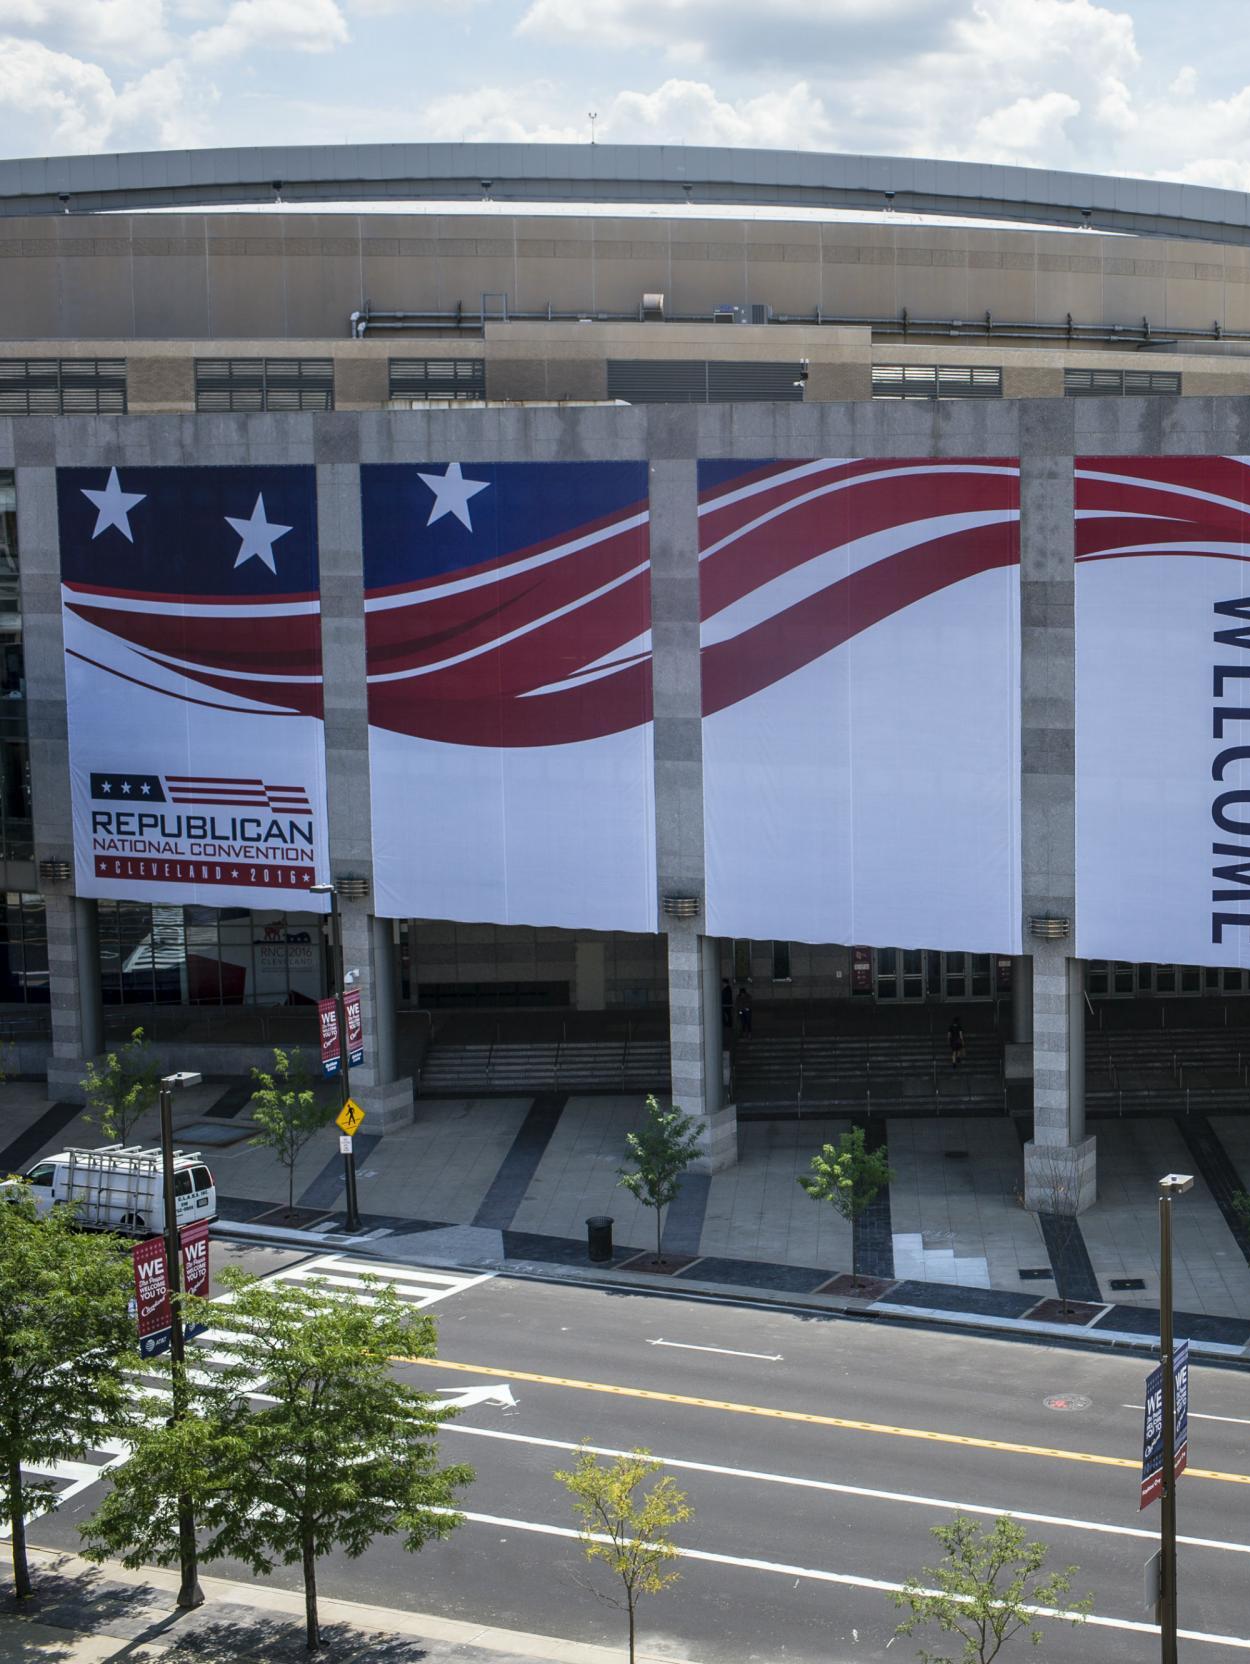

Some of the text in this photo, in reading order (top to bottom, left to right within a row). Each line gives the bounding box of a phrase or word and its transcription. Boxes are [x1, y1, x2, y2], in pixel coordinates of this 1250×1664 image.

[91, 811, 313, 845] REPUBLICAN
[93, 838, 314, 862] NATIONAL CONVENTION
[115, 860, 297, 884] CLEVELAND 2016
[321, 1011, 336, 1024] WE
[347, 1003, 360, 1016] WE
[185, 1239, 206, 1262] WE
[137, 1257, 165, 1280] WE
[186, 1261, 207, 1276] WELCOME
[187, 1267, 207, 1283] YOU TO
[139, 1280, 166, 1294] WELCOME
[140, 1286, 167, 1301] YOU TO
[1147, 1388, 1162, 1416] WE
